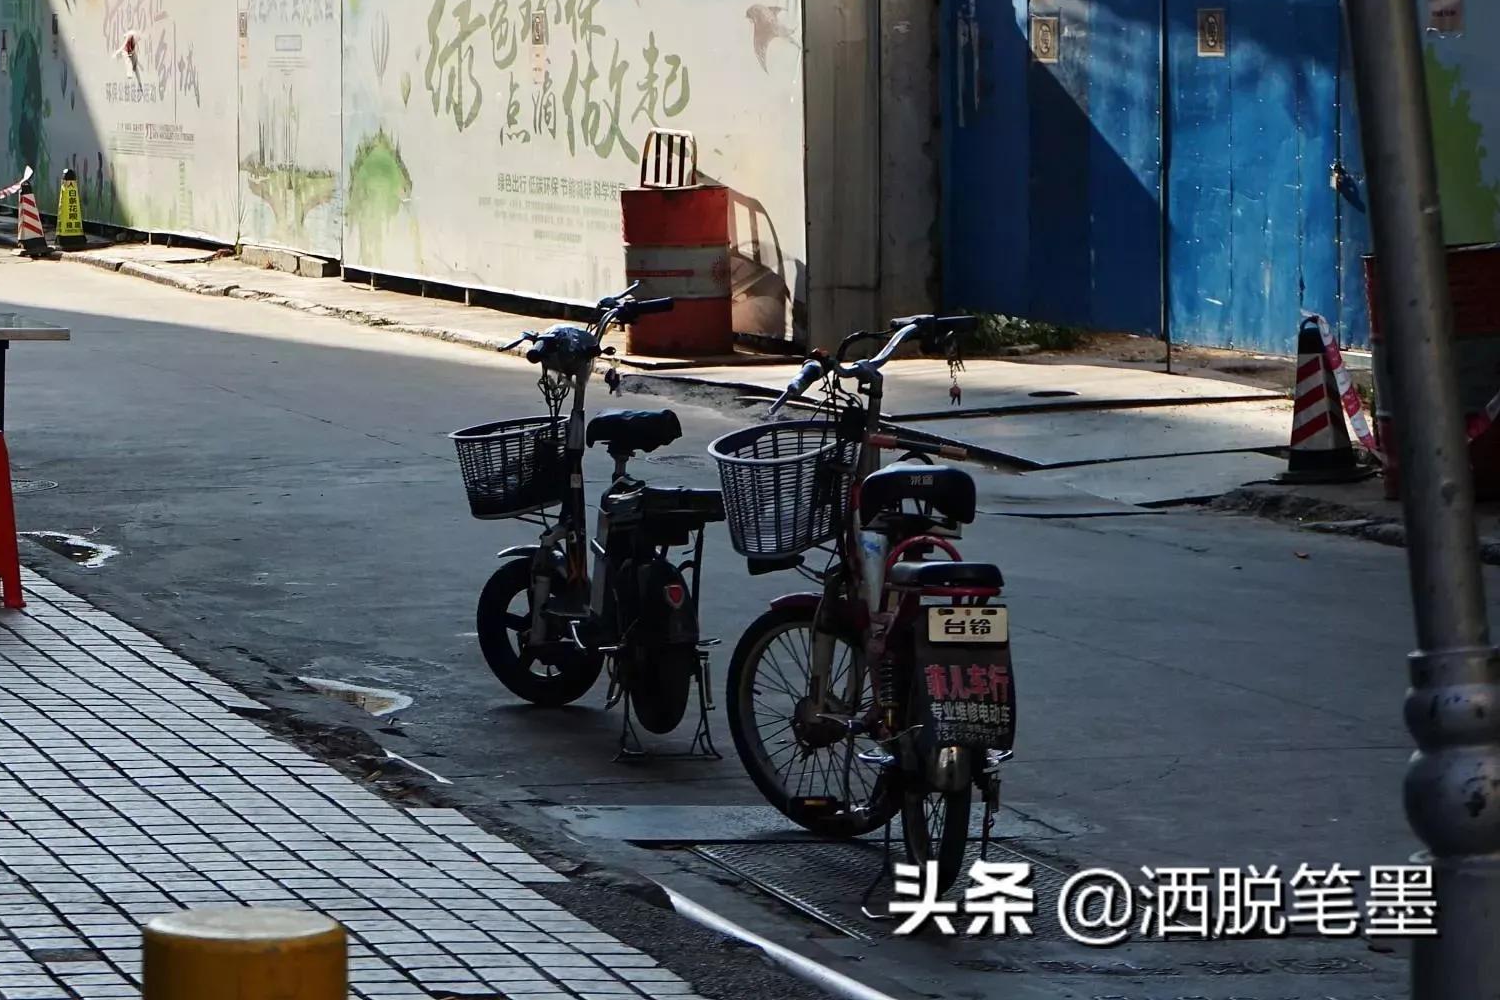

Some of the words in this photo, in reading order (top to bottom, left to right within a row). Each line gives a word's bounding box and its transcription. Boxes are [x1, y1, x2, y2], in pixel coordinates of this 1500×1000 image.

[500, 31, 691, 165] 点滴做起
[497, 173, 527, 194] 绿色出行
[529, 175, 560, 197] 低碳环保
[944, 618, 991, 635] 台铃
[930, 702, 1011, 724] 专业维修电动车
